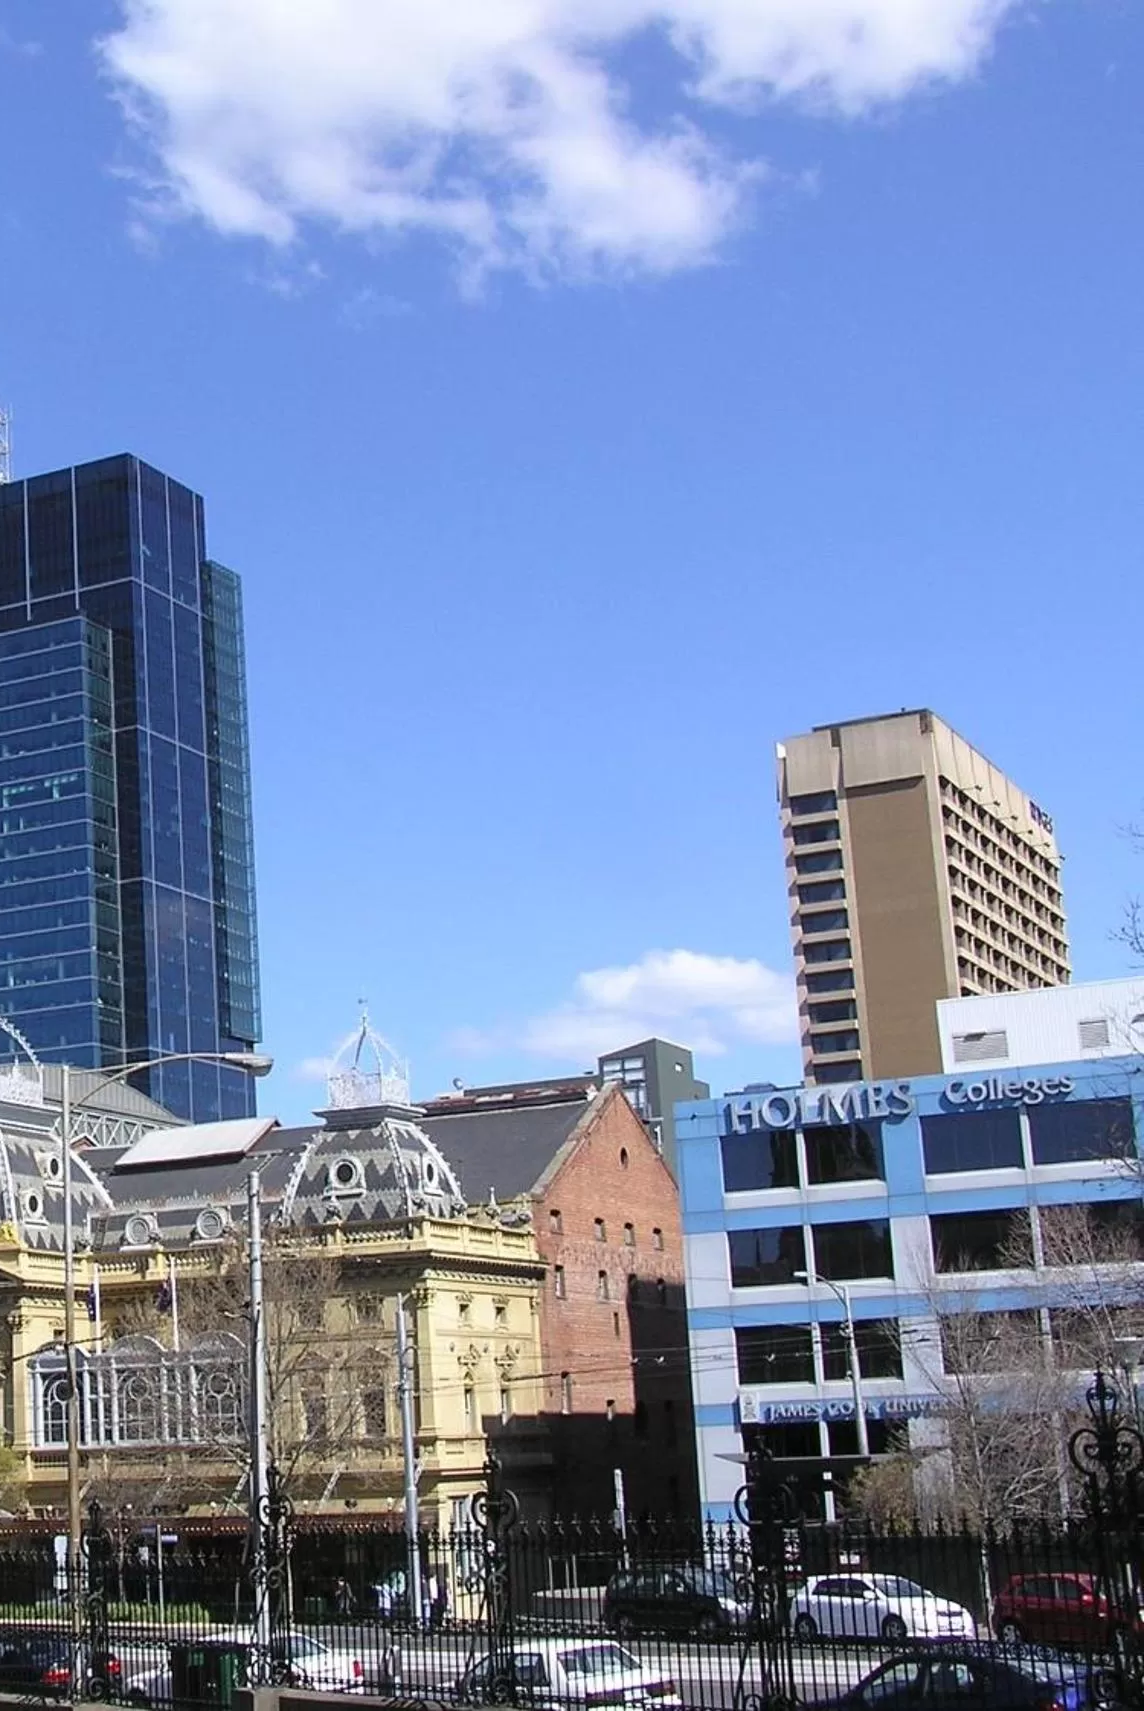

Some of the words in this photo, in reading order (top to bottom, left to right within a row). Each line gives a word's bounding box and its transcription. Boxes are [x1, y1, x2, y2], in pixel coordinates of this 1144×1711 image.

[730, 1084, 915, 1134] HOLMES
[945, 1074, 1076, 1105] Colleges
[768, 1401, 822, 1421] JAMES
